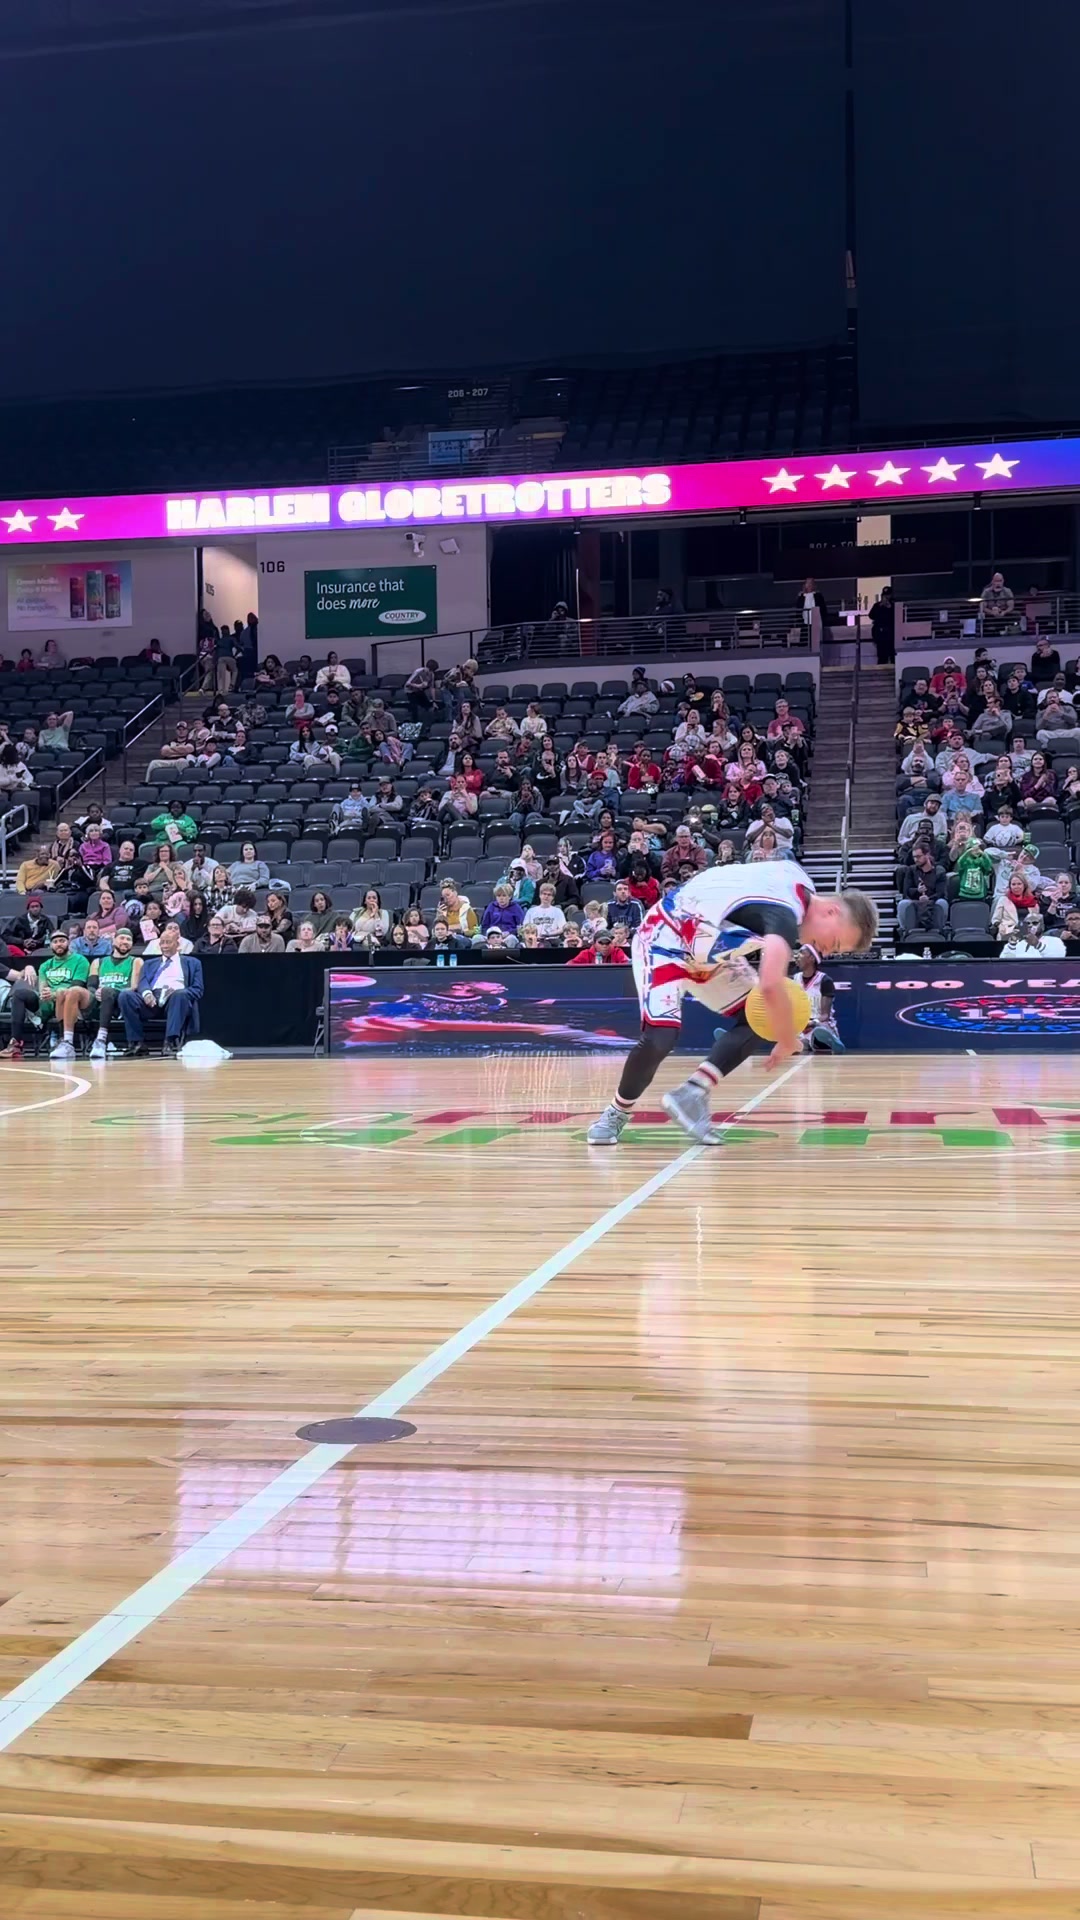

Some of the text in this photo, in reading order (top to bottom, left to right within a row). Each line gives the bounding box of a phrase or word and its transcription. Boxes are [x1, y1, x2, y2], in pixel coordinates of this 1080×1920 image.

[165, 473, 672, 530] HARLEM GLOBETROTTERS
[260, 560, 285, 574] 106
[316, 579, 405, 595] Insurance that
[316, 597, 380, 610] does more
[384, 612, 420, 620] COUNTRY
[866, 980, 965, 990] 100
